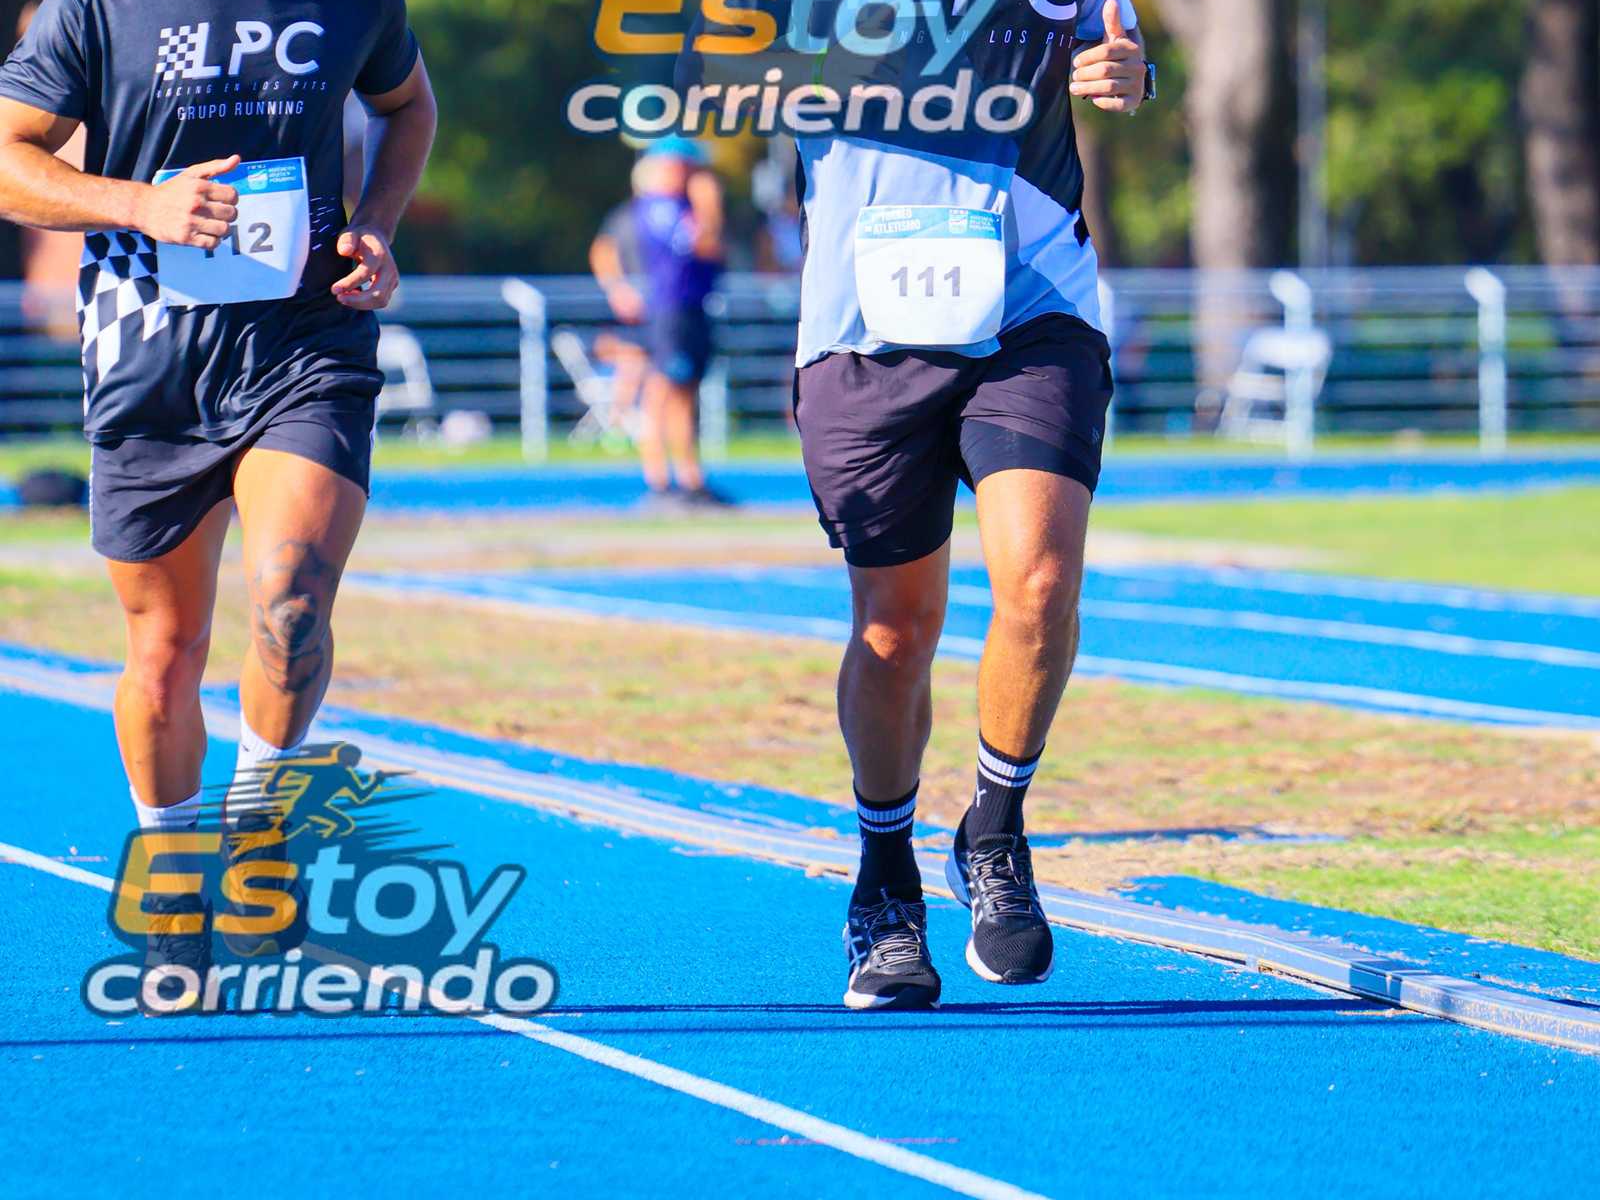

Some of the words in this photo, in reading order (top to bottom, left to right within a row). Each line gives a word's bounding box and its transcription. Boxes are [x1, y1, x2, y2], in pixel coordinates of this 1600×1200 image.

[186, 20, 325, 79] LPC
[989, 29, 1027, 44] LOS
[252, 81, 280, 91] LOS
[292, 80, 327, 90] PITS
[177, 102, 227, 121] GRUPO
[234, 100, 304, 116] RUNNING
[204, 222, 274, 259] 12
[890, 266, 961, 297] 111
